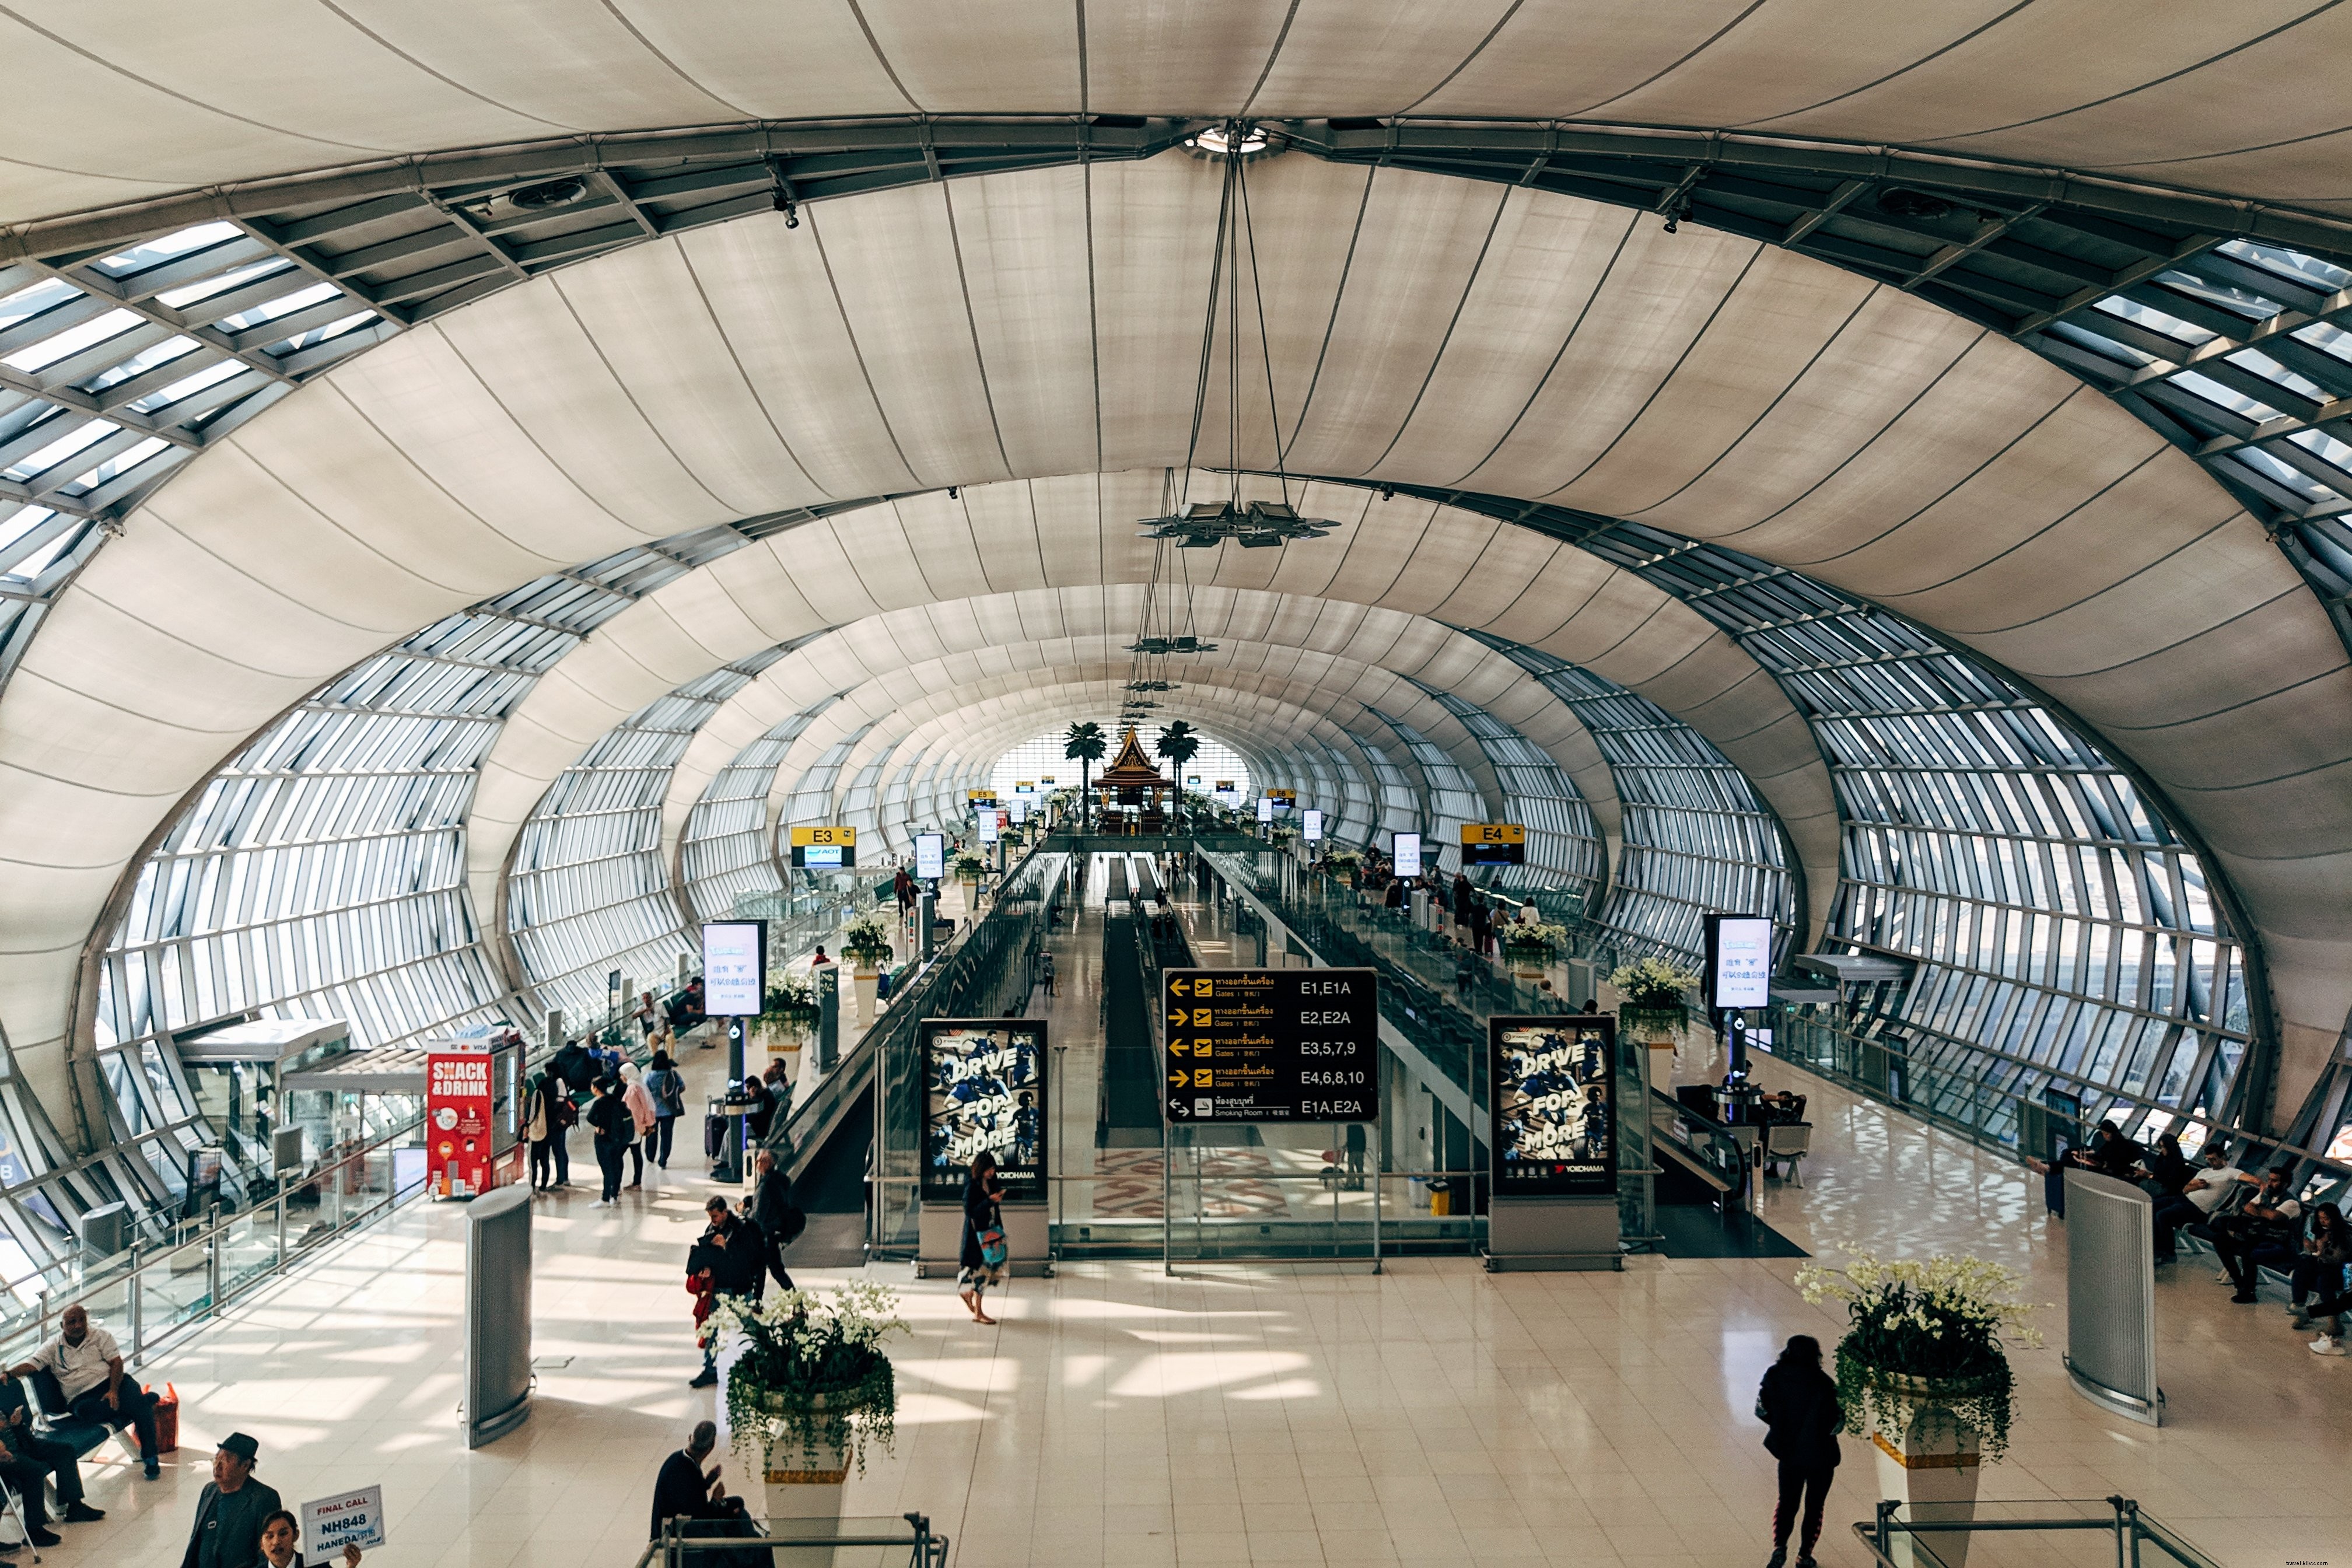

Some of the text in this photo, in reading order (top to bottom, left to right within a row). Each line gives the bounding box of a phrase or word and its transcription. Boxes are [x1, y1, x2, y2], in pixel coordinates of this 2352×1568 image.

[813, 830, 832, 842] E3
[1483, 827, 1503, 841] E4
[1300, 982, 1352, 996] E1,E1A
[1300, 1012, 1351, 1026] E2,E2A
[1300, 1042, 1356, 1056] E3,5,7,9
[949, 1047, 1017, 1083] DRIVE
[1518, 1042, 1586, 1079] DRIVE
[1300, 1072, 1365, 1086] E4,6,8,10
[963, 1094, 1006, 1121] FOR
[1301, 1100, 1362, 1114] E1A,E2A
[1532, 1089, 1578, 1116] FOR
[1215, 1109, 1242, 1118] Smoking
[954, 1125, 1016, 1158] MORE
[1525, 1120, 1586, 1152] MORE
[317, 1497, 368, 1516] FINAL CALL
[321, 1513, 366, 1535] NH848
